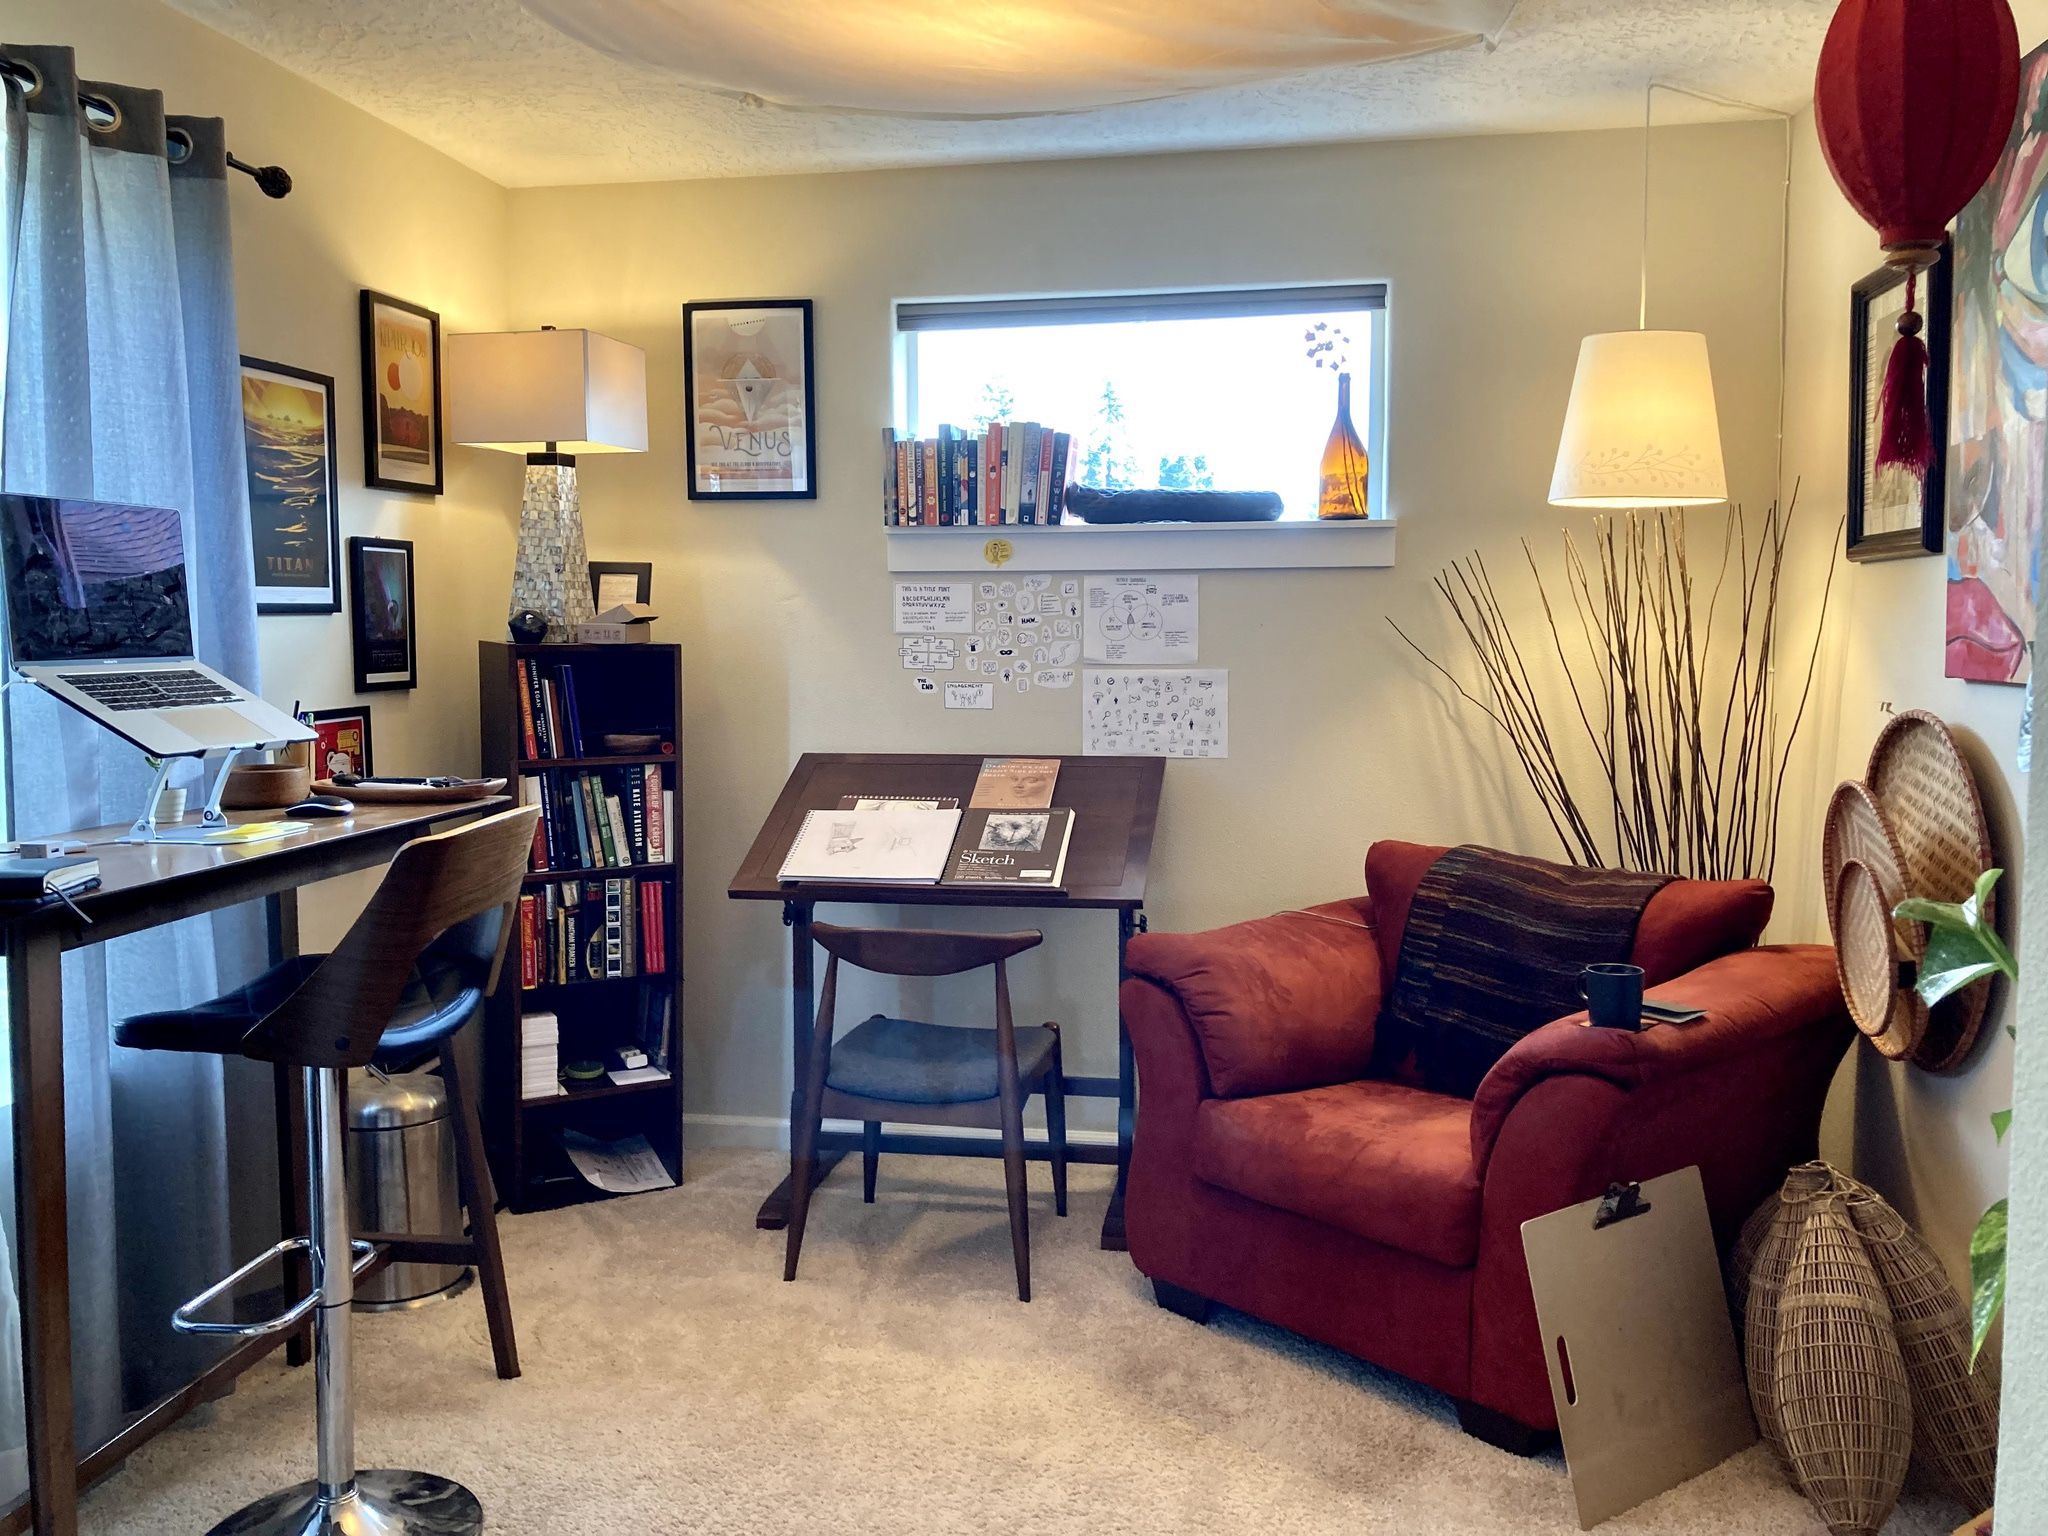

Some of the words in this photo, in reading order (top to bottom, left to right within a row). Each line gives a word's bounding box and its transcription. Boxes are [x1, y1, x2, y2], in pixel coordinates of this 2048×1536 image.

[709, 425, 791, 456] VENUS
[1053, 471, 1061, 512] POWER
[265, 556, 314, 570] TITAN
[632, 788, 641, 807] KATE
[651, 774, 660, 800] FOURTH
[634, 810, 642, 847] ATKINSON
[652, 810, 660, 826] JULY
[652, 826, 660, 847] CREEK
[960, 853, 1015, 865] Sketch
